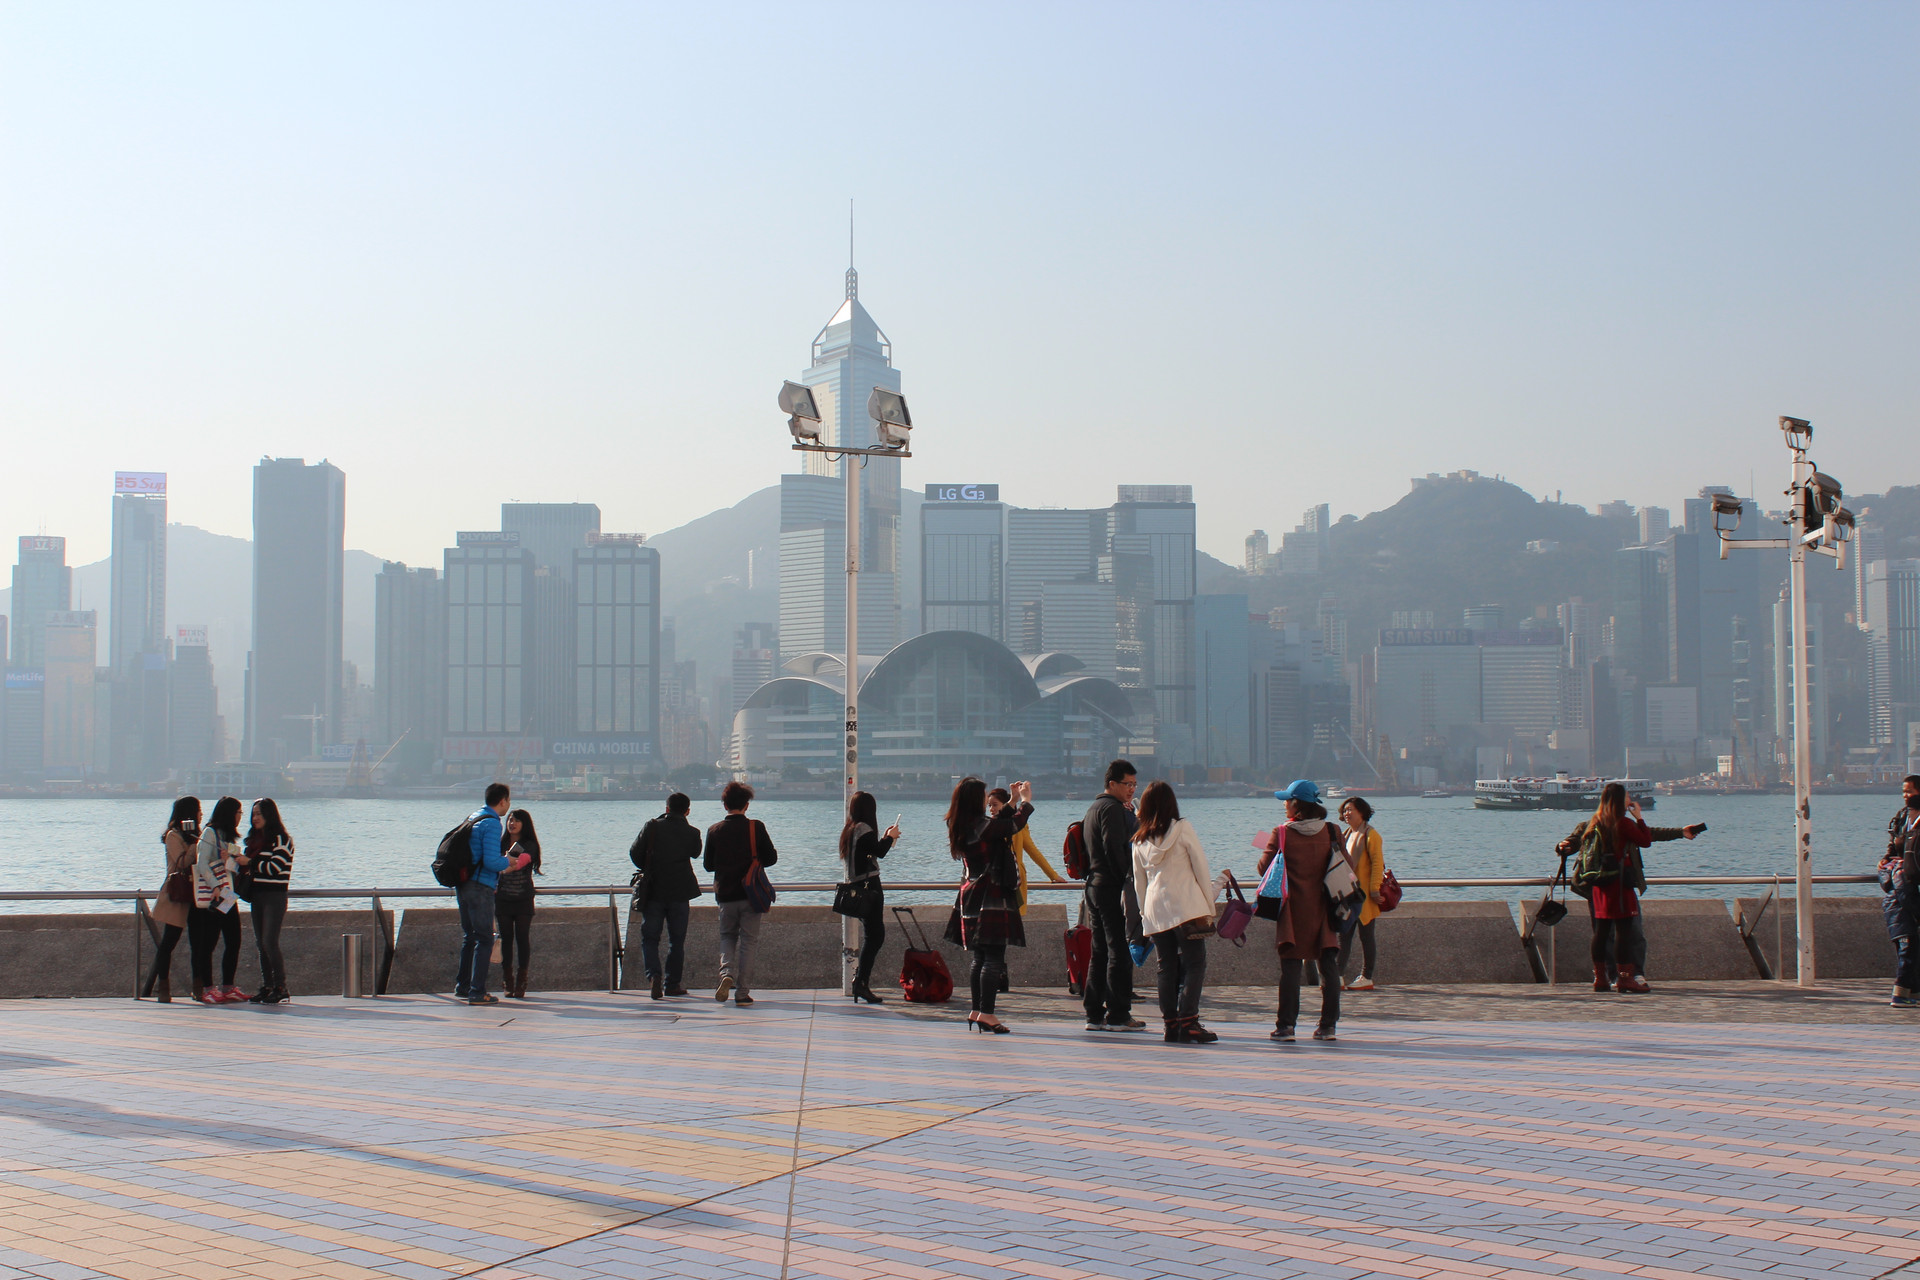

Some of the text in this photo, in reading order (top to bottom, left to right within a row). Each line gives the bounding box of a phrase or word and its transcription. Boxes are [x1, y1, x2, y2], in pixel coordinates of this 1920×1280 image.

[939, 485, 985, 500] LG G3
[459, 532, 519, 541] OLYMPUS
[1384, 630, 1468, 644] SAMSUNG
[6, 672, 44, 681] MetLife
[445, 739, 542, 756] HITACHI
[553, 742, 651, 754] CHINA MOBILE
